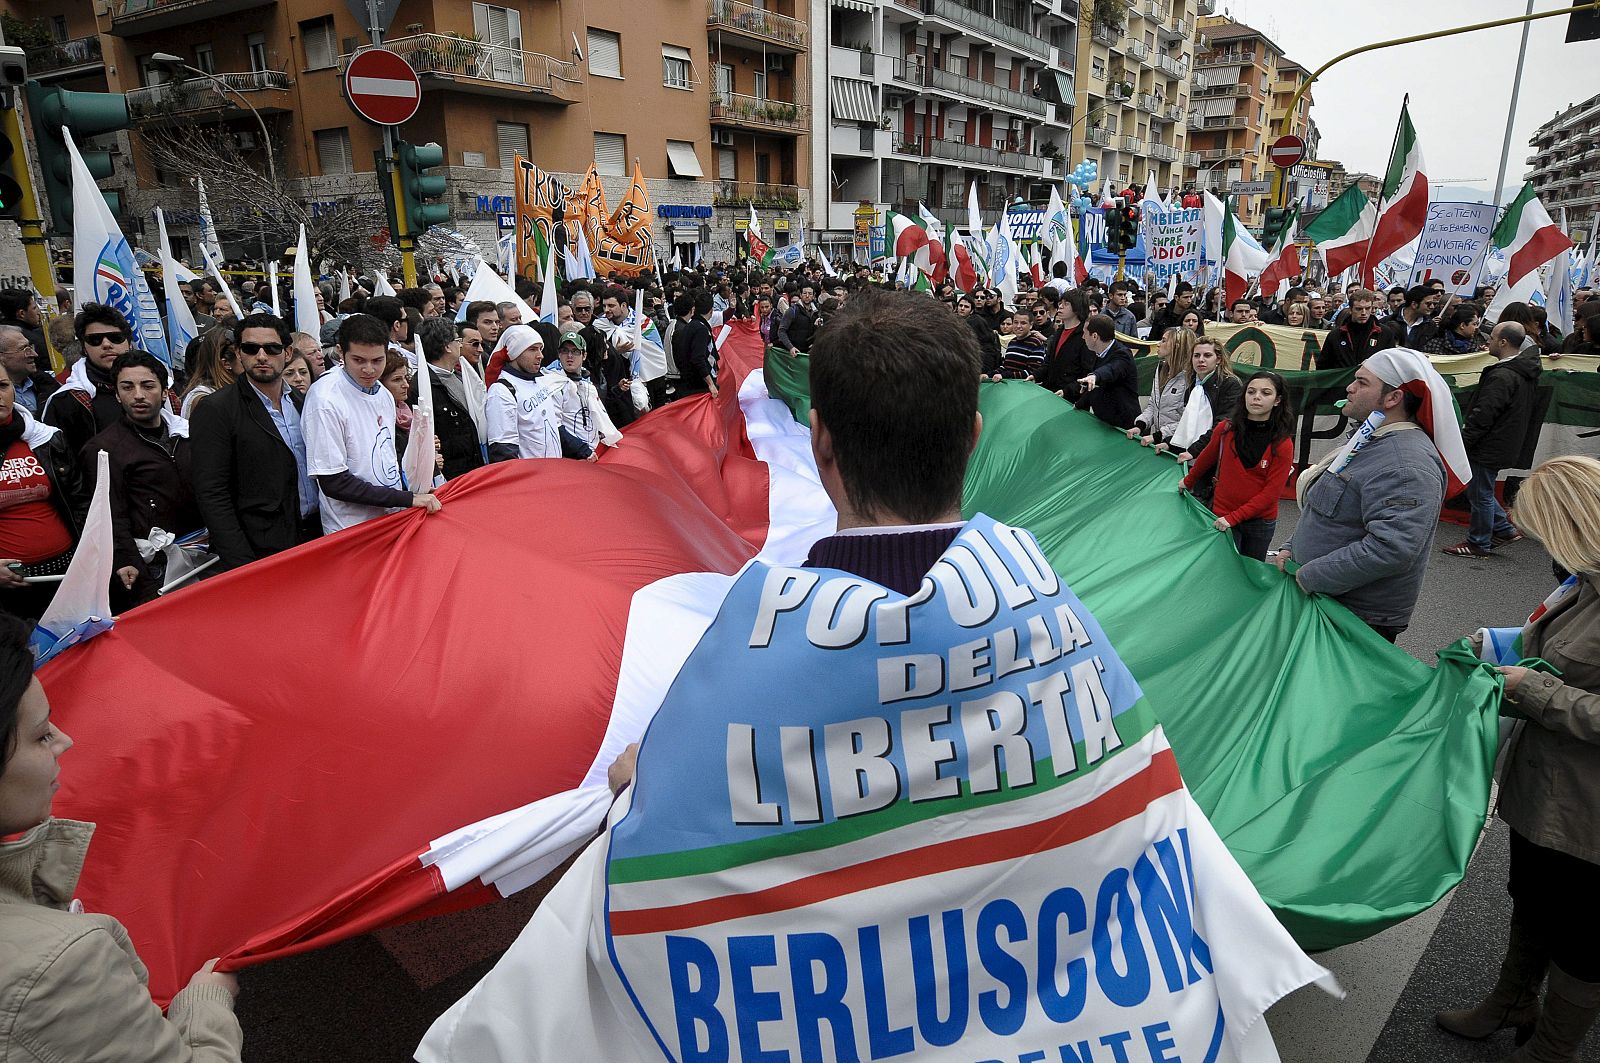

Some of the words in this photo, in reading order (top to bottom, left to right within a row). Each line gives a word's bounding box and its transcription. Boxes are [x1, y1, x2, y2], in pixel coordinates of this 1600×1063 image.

[1449, 224, 1488, 234] BAMBINO
[1441, 239, 1480, 251] VOTARE
[1426, 253, 1473, 266] BONINO
[877, 603, 1092, 704] DELLA
